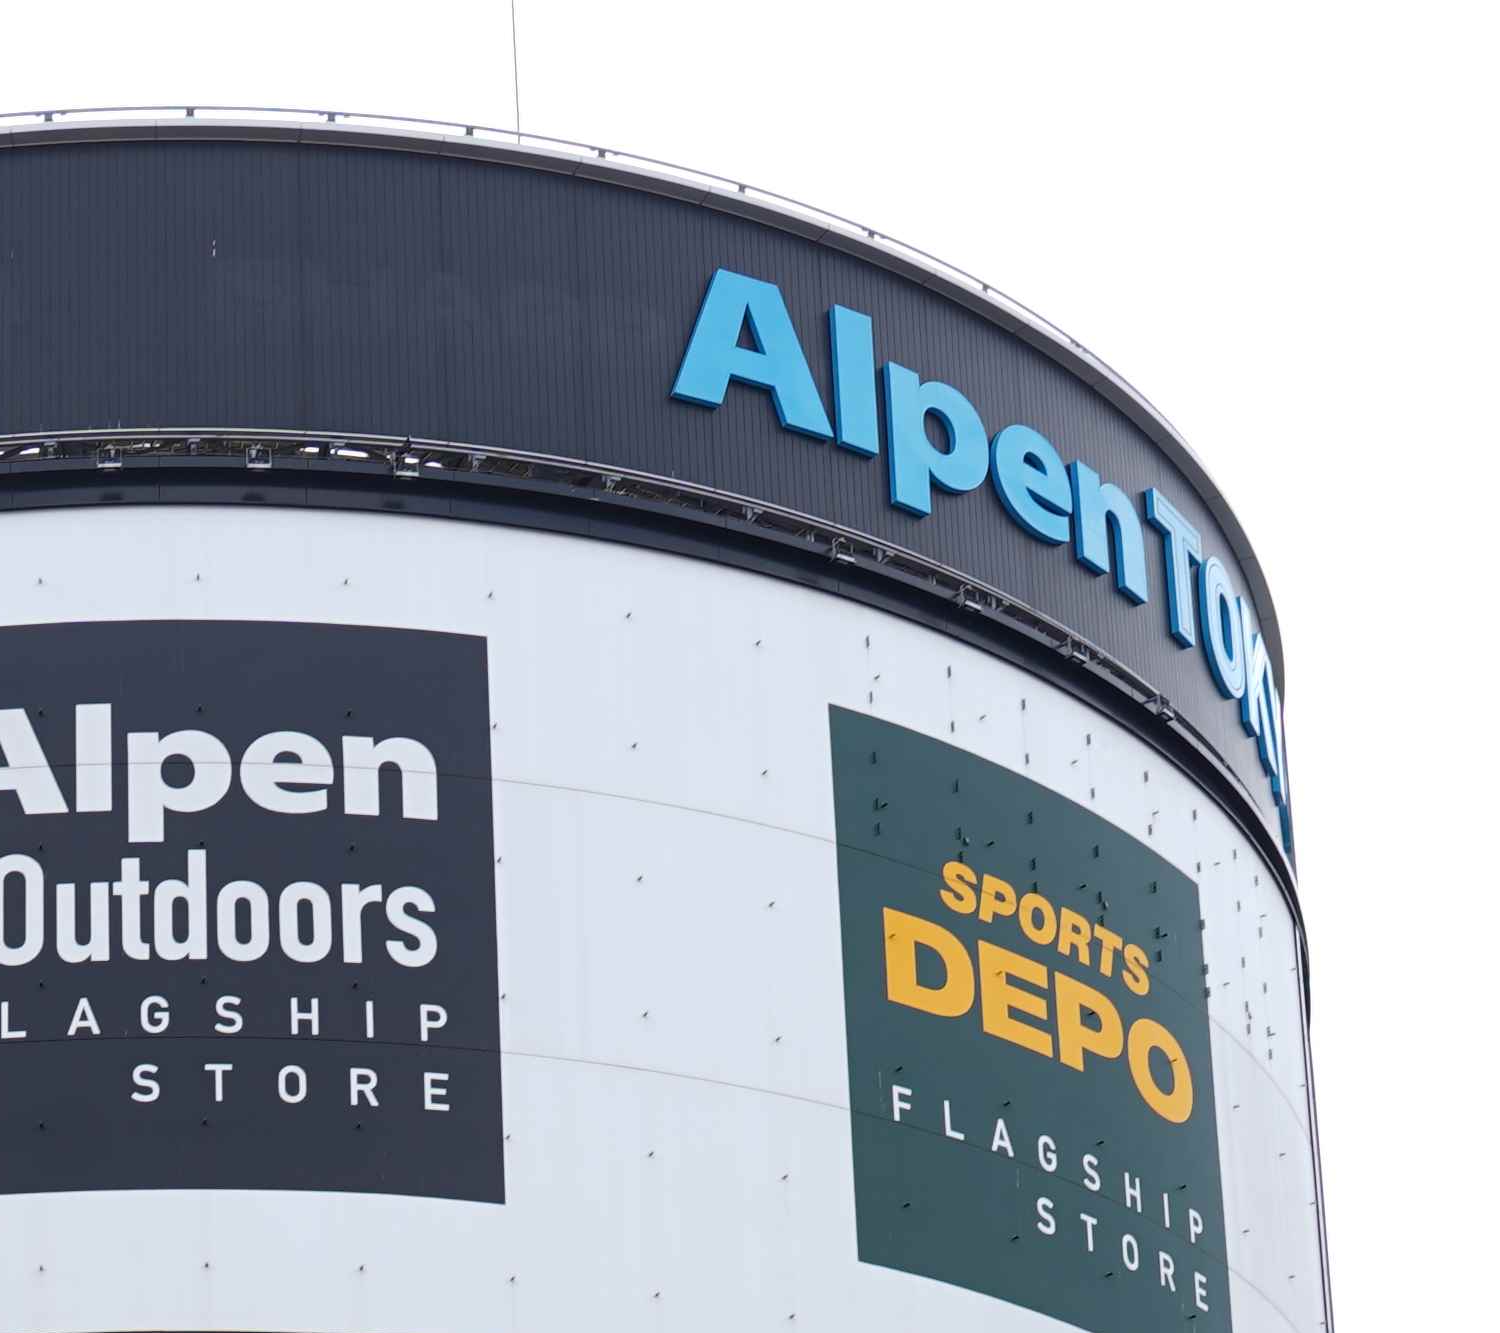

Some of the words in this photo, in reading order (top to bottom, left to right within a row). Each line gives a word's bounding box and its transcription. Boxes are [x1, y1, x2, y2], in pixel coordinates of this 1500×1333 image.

[670, 267, 1148, 606] Alpen
[1145, 486, 1294, 855] TOKY
[939, 860, 1152, 997] SPORTS
[131, 1063, 451, 1112] STORE
[882, 906, 1195, 1124] DEPO
[891, 1085, 1205, 1240] FLAGSHIP
[1036, 1197, 1210, 1313] STORE
